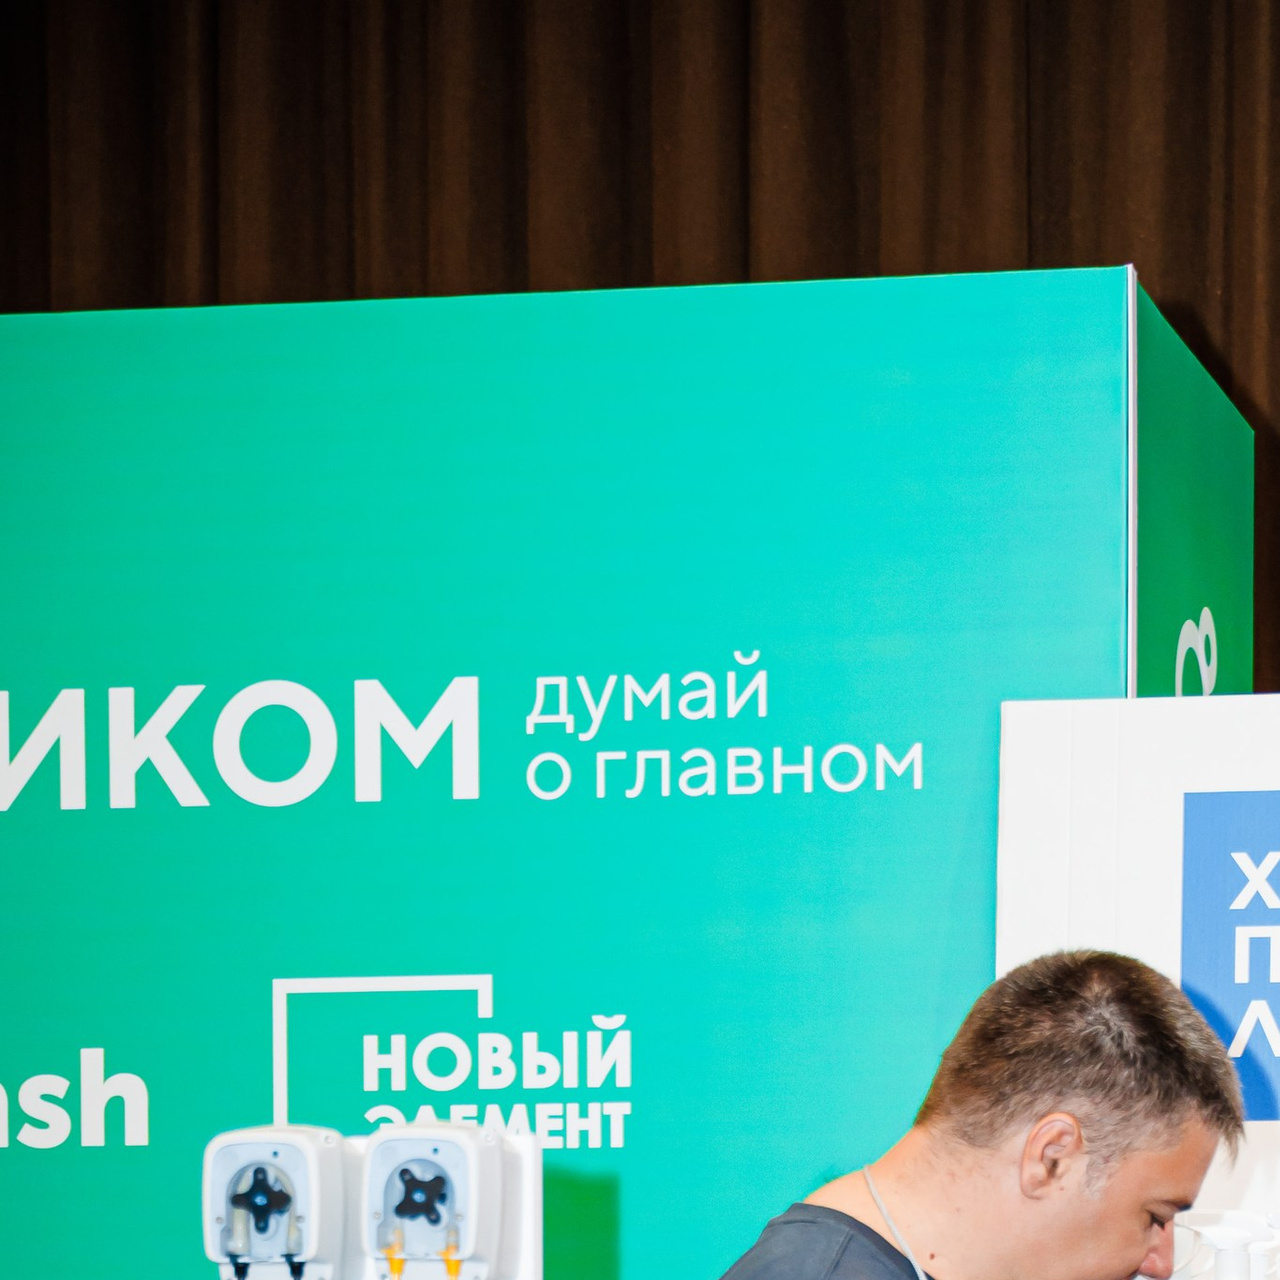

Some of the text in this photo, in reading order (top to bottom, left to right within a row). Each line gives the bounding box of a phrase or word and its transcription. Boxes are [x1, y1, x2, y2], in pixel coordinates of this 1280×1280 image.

[525, 649, 770, 741] думай
[0, 676, 480, 812] ИКОМ
[525, 743, 925, 800] о главном
[0, 1047, 149, 1149] sh
[362, 1014, 632, 1092] НОВЫЙ
